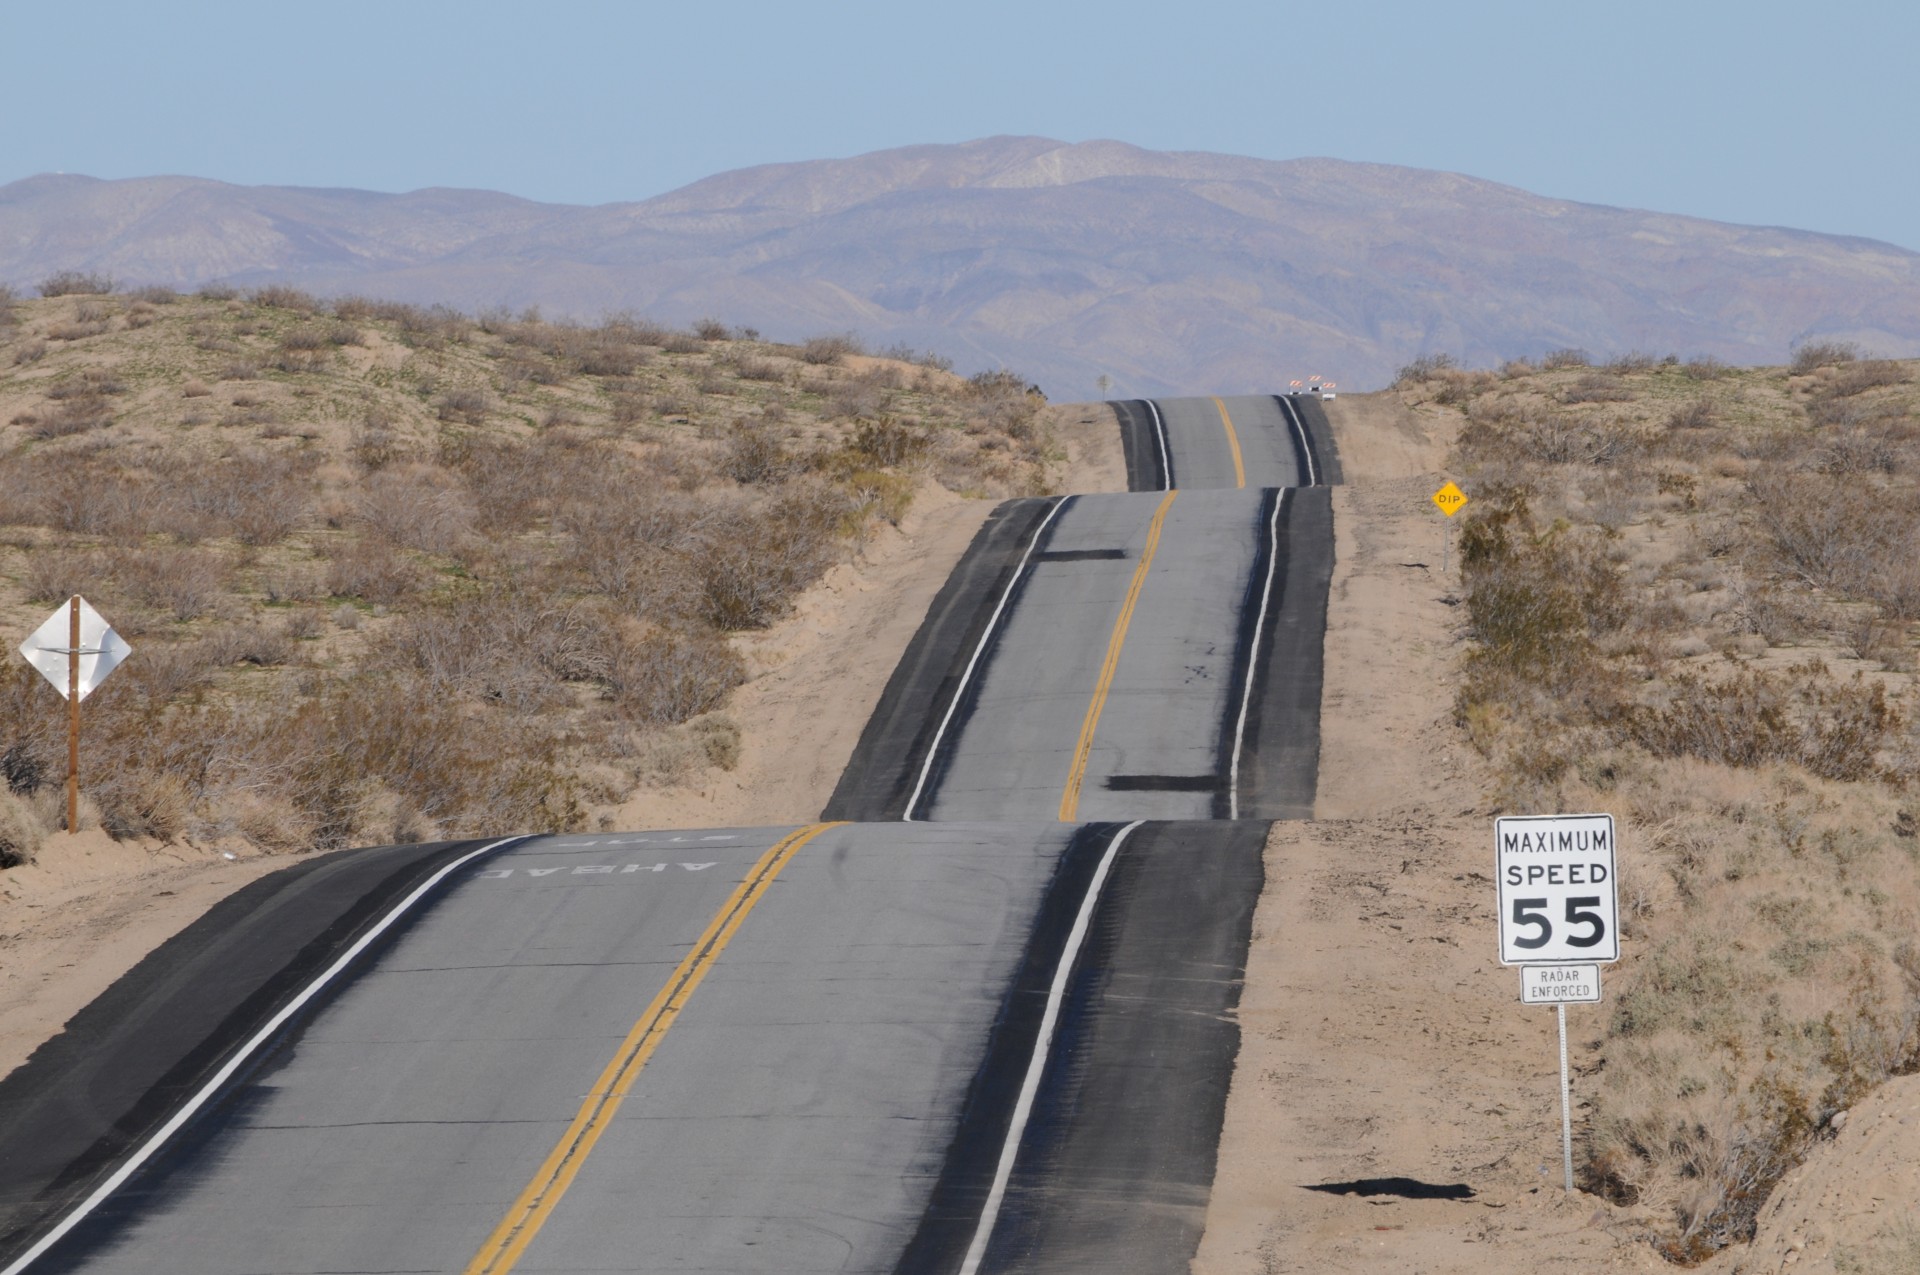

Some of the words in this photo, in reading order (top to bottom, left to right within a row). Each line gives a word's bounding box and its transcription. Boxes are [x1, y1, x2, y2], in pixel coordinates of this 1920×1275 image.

[1438, 494, 1461, 504] DIP
[1504, 830, 1607, 853] MAXIMUM
[1506, 863, 1608, 886] SPEED
[1512, 896, 1605, 949] 55
[1541, 970, 1580, 983] RADAR
[1532, 984, 1590, 998] ENFORCED
